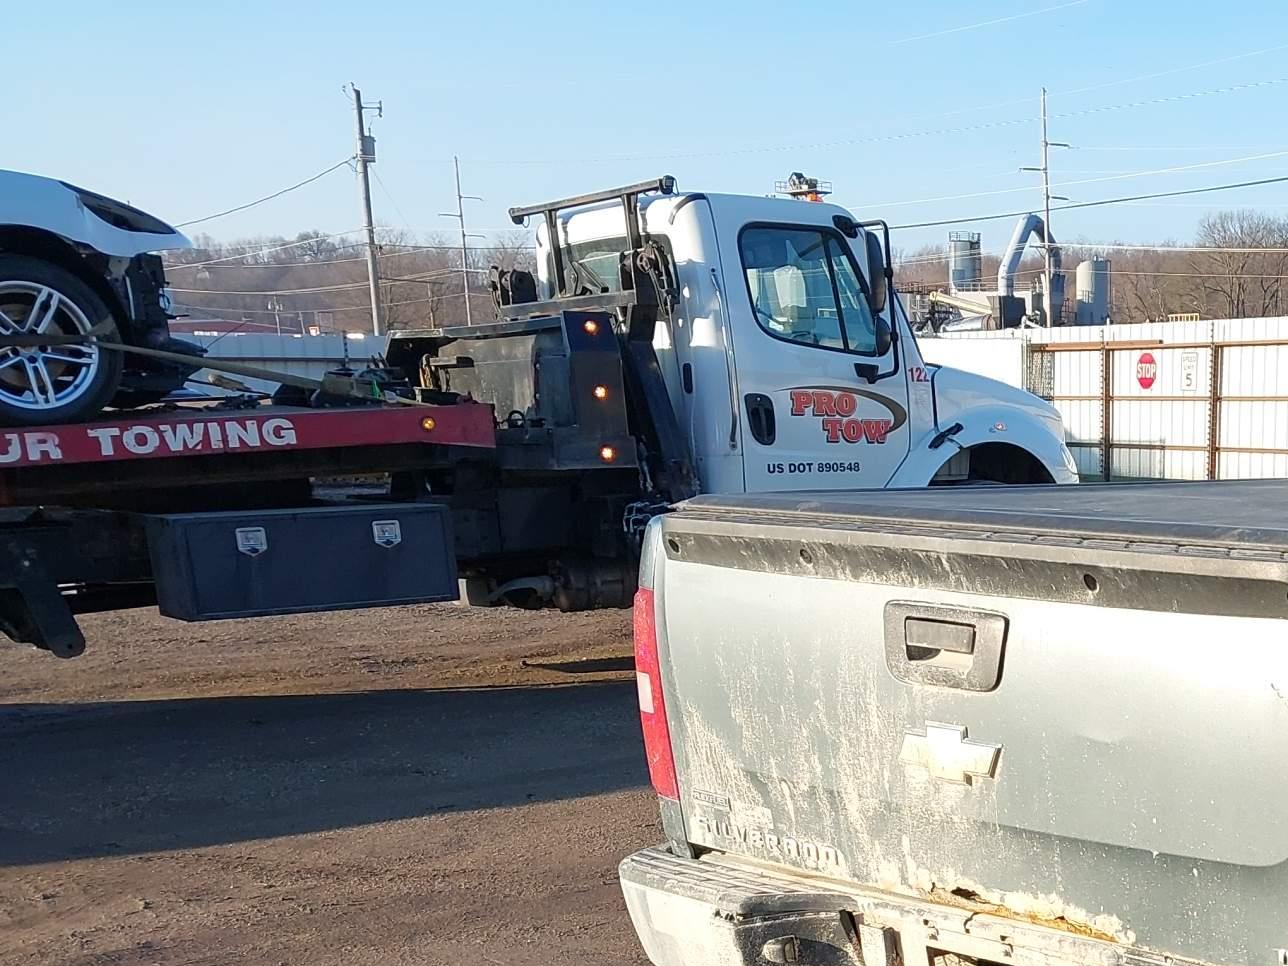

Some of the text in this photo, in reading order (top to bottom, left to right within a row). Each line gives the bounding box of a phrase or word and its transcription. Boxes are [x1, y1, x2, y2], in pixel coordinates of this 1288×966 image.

[1137, 363, 1157, 379] STOP
[1185, 372, 1193, 387] 5
[790, 391, 857, 417] PRO
[88, 418, 297, 456] TOWING
[822, 418, 891, 444] TOW
[767, 462, 860, 474] US DOT 890548
